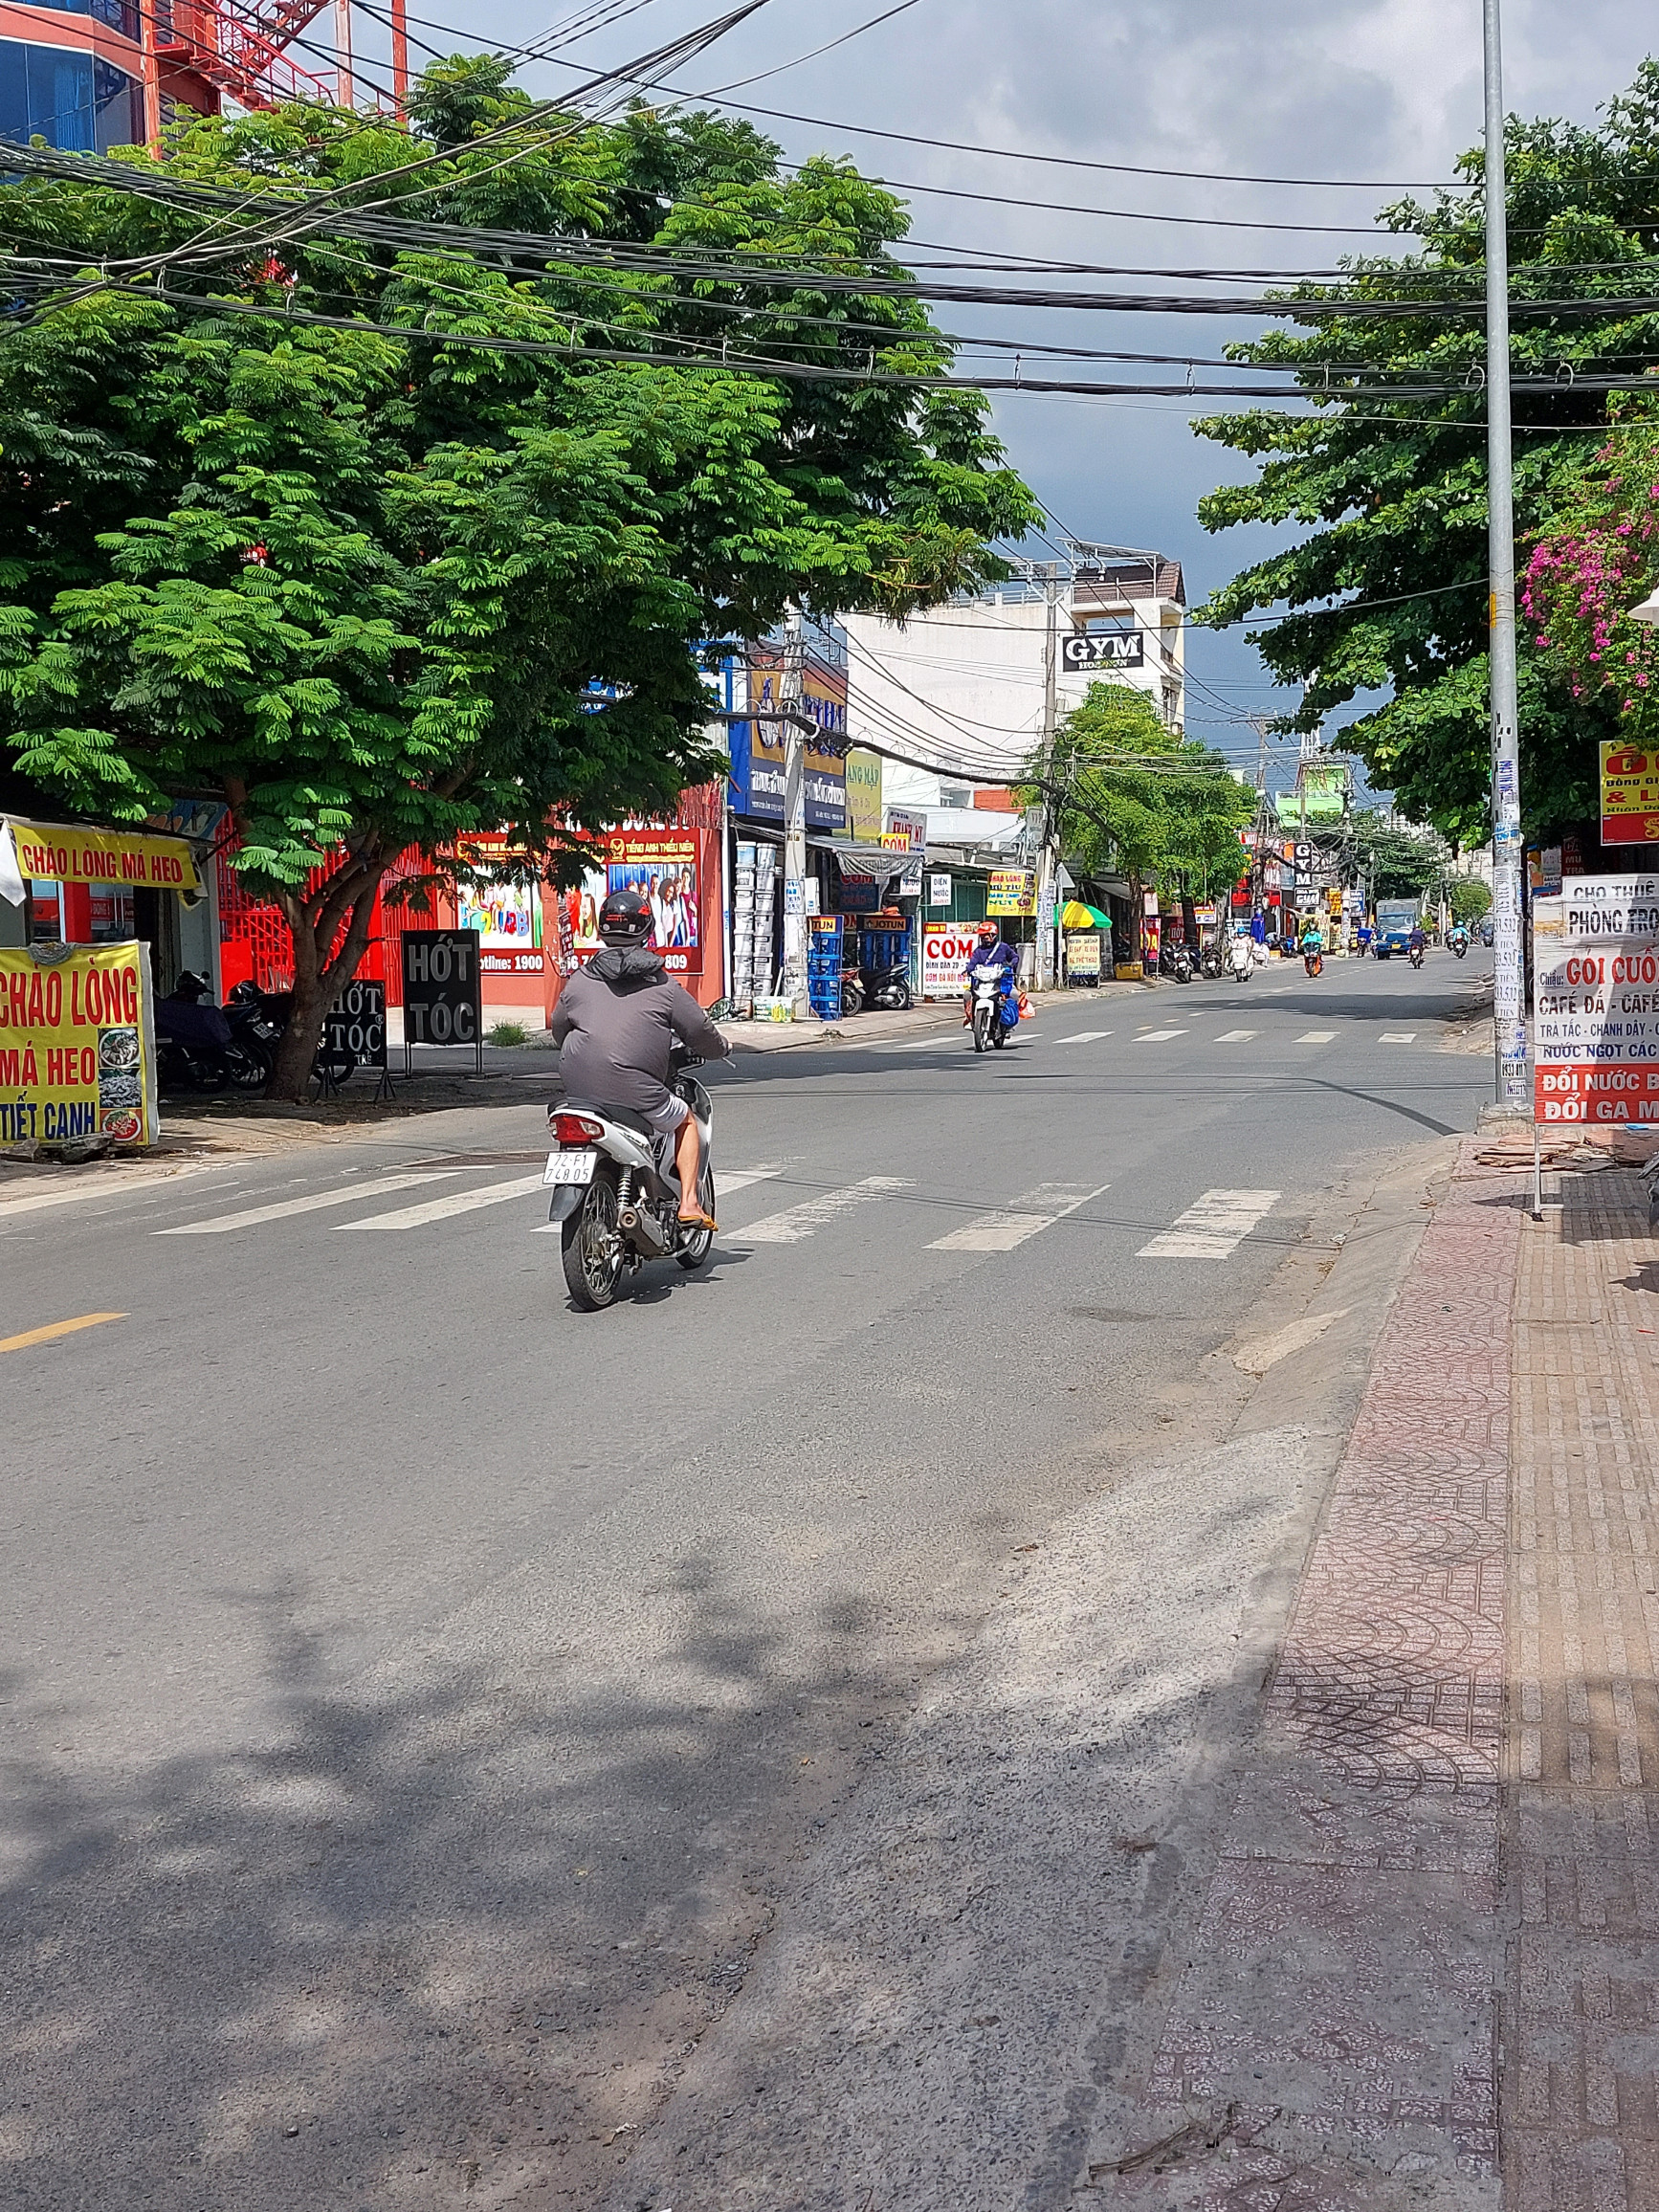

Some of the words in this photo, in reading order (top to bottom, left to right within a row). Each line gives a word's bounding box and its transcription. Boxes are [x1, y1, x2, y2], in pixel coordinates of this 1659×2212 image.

[1066, 635, 1140, 661] GYM
[22, 841, 68, 875] CHÁO
[73, 843, 116, 878] LÒNG
[122, 849, 147, 880] MÁ
[151, 855, 184, 883] HEO
[1574, 886, 1607, 898] CHO
[1611, 880, 1655, 896] THUÊ
[813, 920, 833, 929] TUN
[874, 920, 904, 929] JOTUN
[1569, 903, 1624, 935] PHÒNG
[1627, 907, 1659, 938] TRỌ
[409, 934, 473, 982] HỚT
[926, 936, 974, 960] CƠM
[515, 956, 543, 970] 1900
[0, 962, 63, 1029] CHÁO
[71, 957, 138, 1027] LÒNG
[1538, 990, 1578, 1015] CAFÉ
[1583, 989, 1605, 1014] ĐÁ
[409, 992, 475, 1040] TÓC
[1540, 1021, 1559, 1037] TRÀ
[1590, 1023, 1623, 1037] CHANH
[1626, 1019, 1647, 1036] DÂY
[330, 1016, 383, 1051] TÓC
[1543, 1042, 1582, 1058] NƯỚC
[1586, 1044, 1624, 1060] NGỌT
[1628, 1040, 1657, 1057] CÁC
[0, 1040, 39, 1087] MÁ
[47, 1047, 97, 1086] HEO
[1542, 1065, 1579, 1091] ĐỔI
[1584, 1070, 1641, 1091] NƯỚC
[0, 1091, 37, 1141] TIẾT
[44, 1101, 97, 1141] CANH
[1544, 1092, 1588, 1120] ĐỔI
[1596, 1100, 1630, 1119] GA
